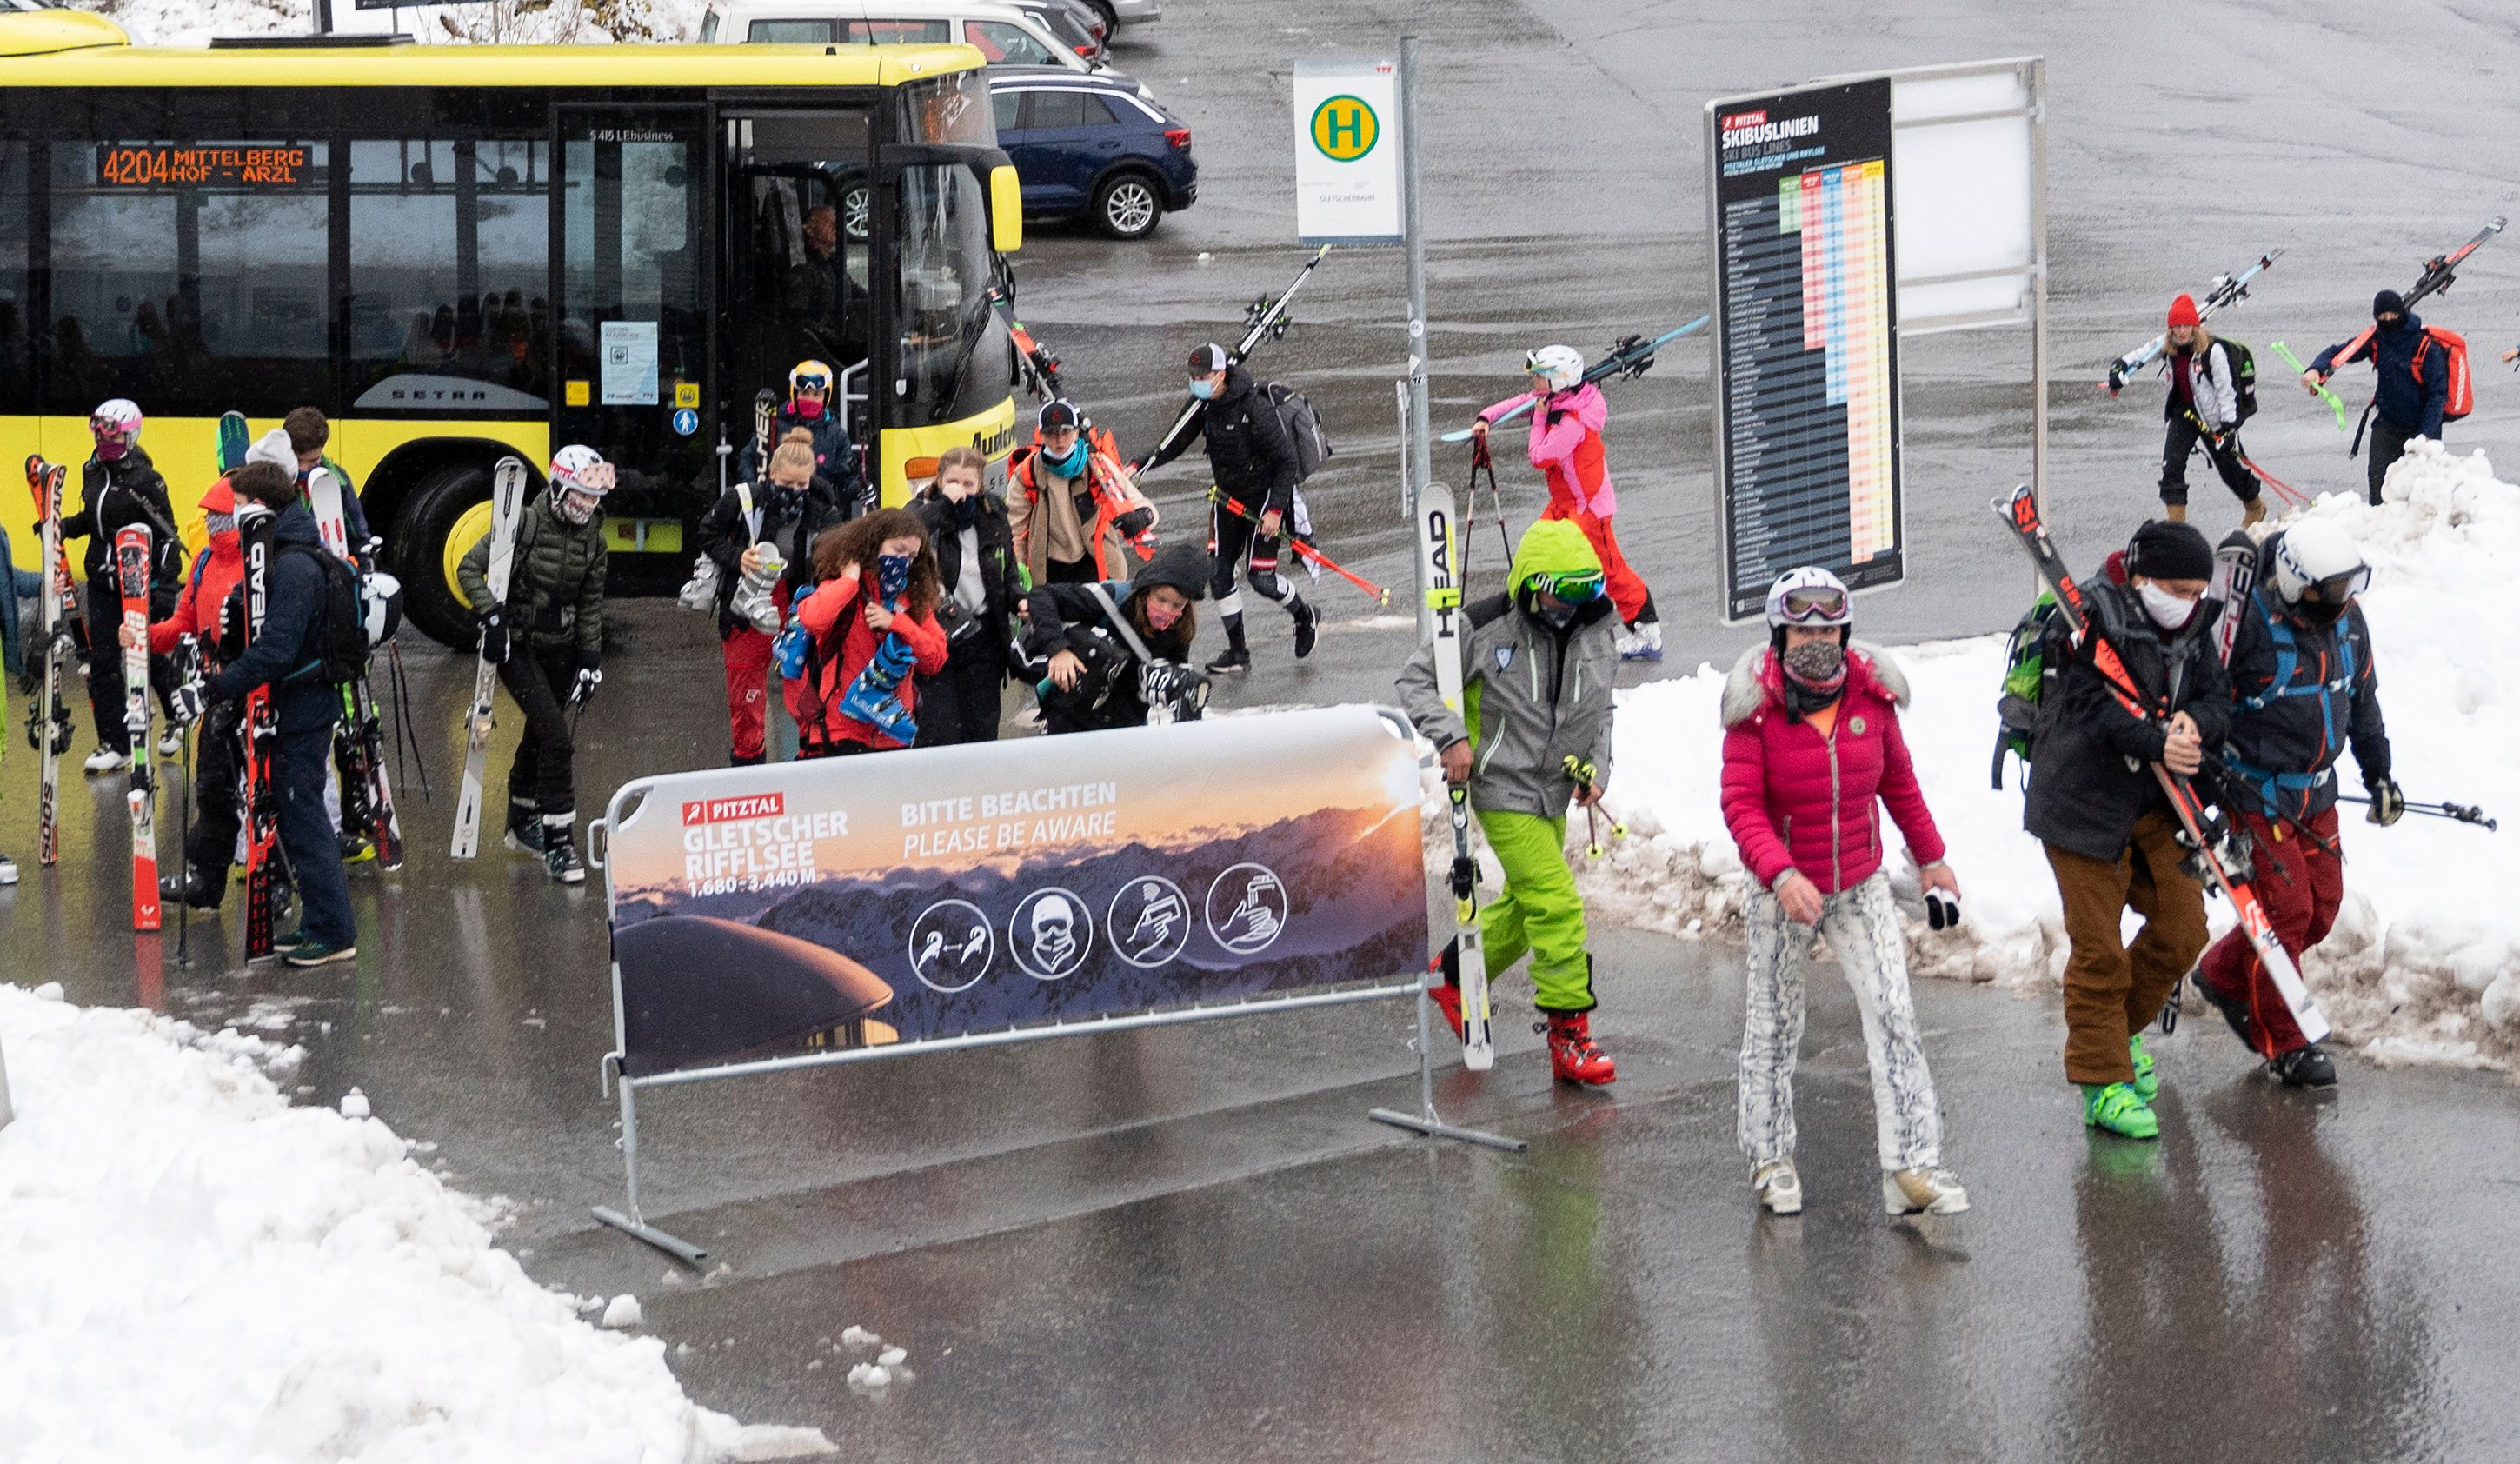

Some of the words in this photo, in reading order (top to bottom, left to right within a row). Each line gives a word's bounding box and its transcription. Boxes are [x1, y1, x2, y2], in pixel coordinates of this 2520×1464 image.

[1328, 109, 1361, 149] H
[1722, 115, 1819, 150] SKIBUSLINIEN
[1734, 114, 1765, 128] PITZTAL
[103, 150, 169, 184] 4204
[173, 149, 303, 168] MITTELBERG
[1723, 147, 1739, 162] SKI
[1741, 144, 1762, 158] BUS
[1763, 139, 1792, 155] LINES
[241, 165, 297, 183] ARZL
[392, 389, 486, 400] SETRA
[1428, 509, 1455, 638] HEAD
[250, 541, 267, 644] HEAD
[712, 796, 780, 820] PITZTAL
[901, 795, 974, 828] BITTE
[981, 781, 1117, 819] BEACHTEN
[682, 809, 850, 854] GLETSCHER
[903, 824, 991, 860] PLEASE
[996, 820, 1026, 848] BE
[1030, 809, 1118, 845] AWARE
[684, 839, 815, 882] RIFFLSEE
